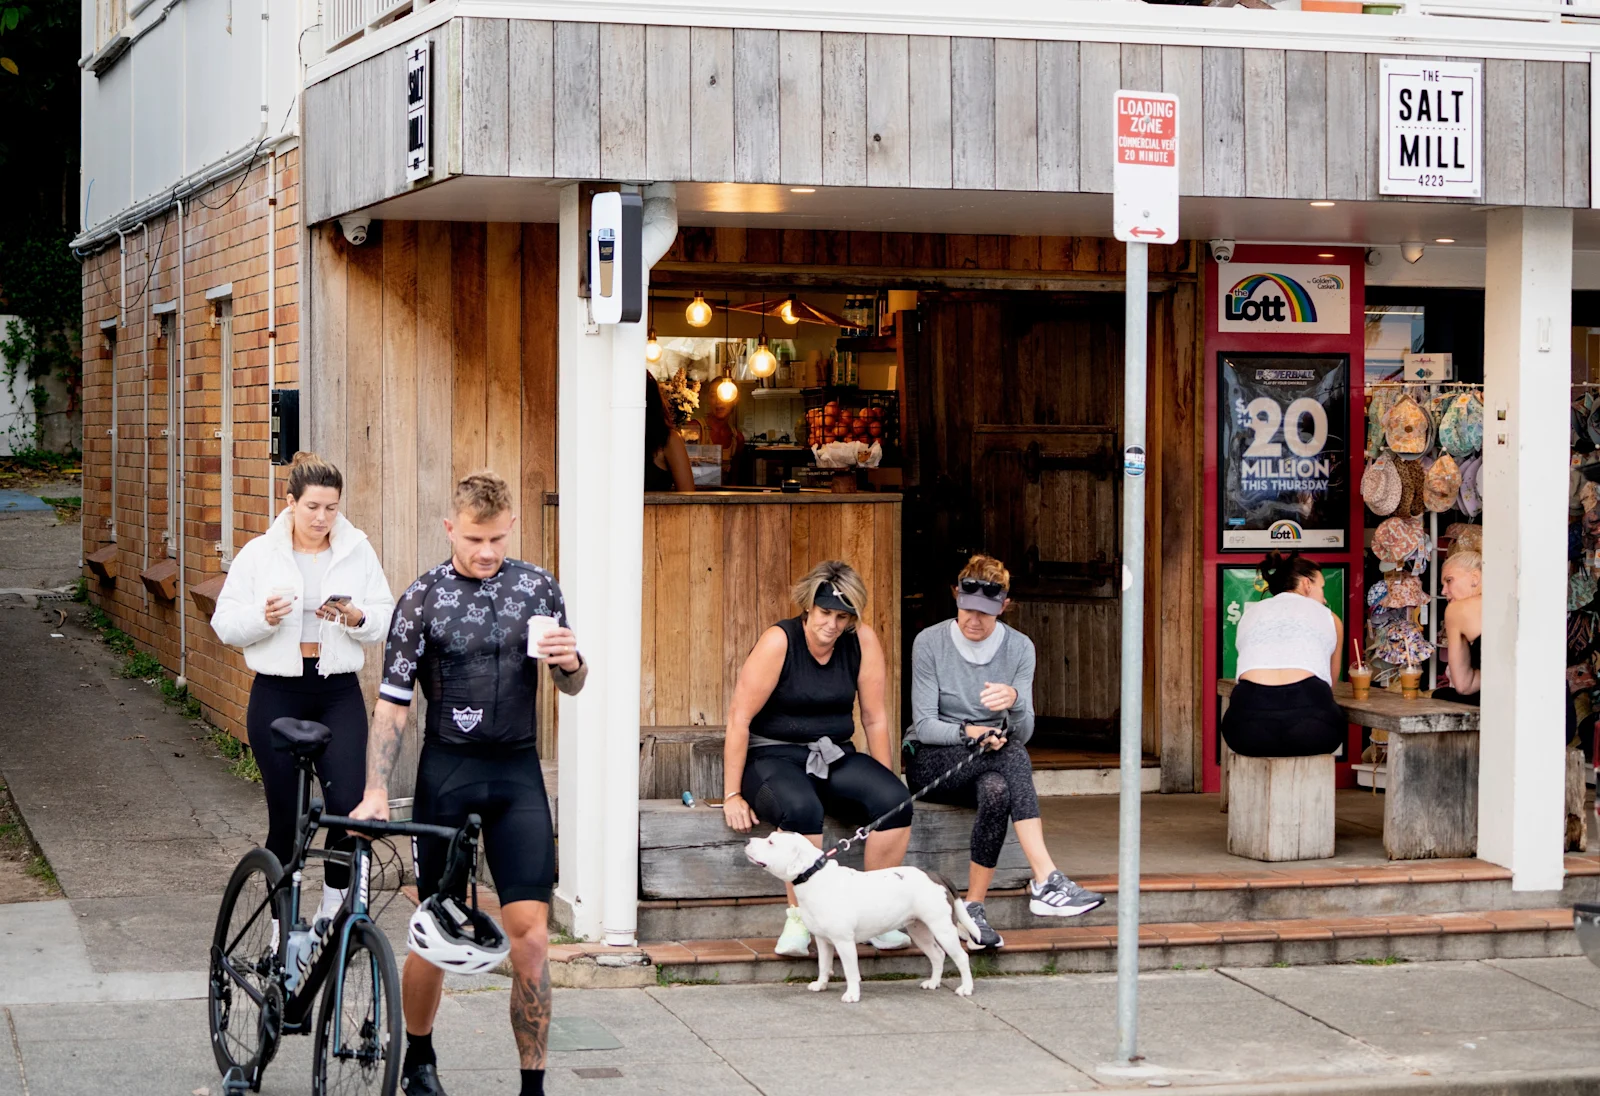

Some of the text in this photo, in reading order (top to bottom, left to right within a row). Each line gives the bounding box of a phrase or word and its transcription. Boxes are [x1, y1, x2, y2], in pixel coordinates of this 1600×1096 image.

[1422, 69, 1440, 82] THE
[1119, 99, 1174, 118] LOADING
[1399, 88, 1464, 123] SALT
[1129, 116, 1164, 134] ZONE
[1118, 136, 1161, 150] COMMERCIAL
[1124, 149, 1169, 163] 20 MINUTE
[1400, 134, 1465, 169] MILL
[1418, 174, 1444, 187] 4223
[1234, 289, 1248, 297] the
[1225, 294, 1286, 322] Lott
[1241, 459, 1330, 479] MILLION
[1241, 479, 1329, 491] THIS THURSDAY
[1270, 530, 1291, 539] Lott
